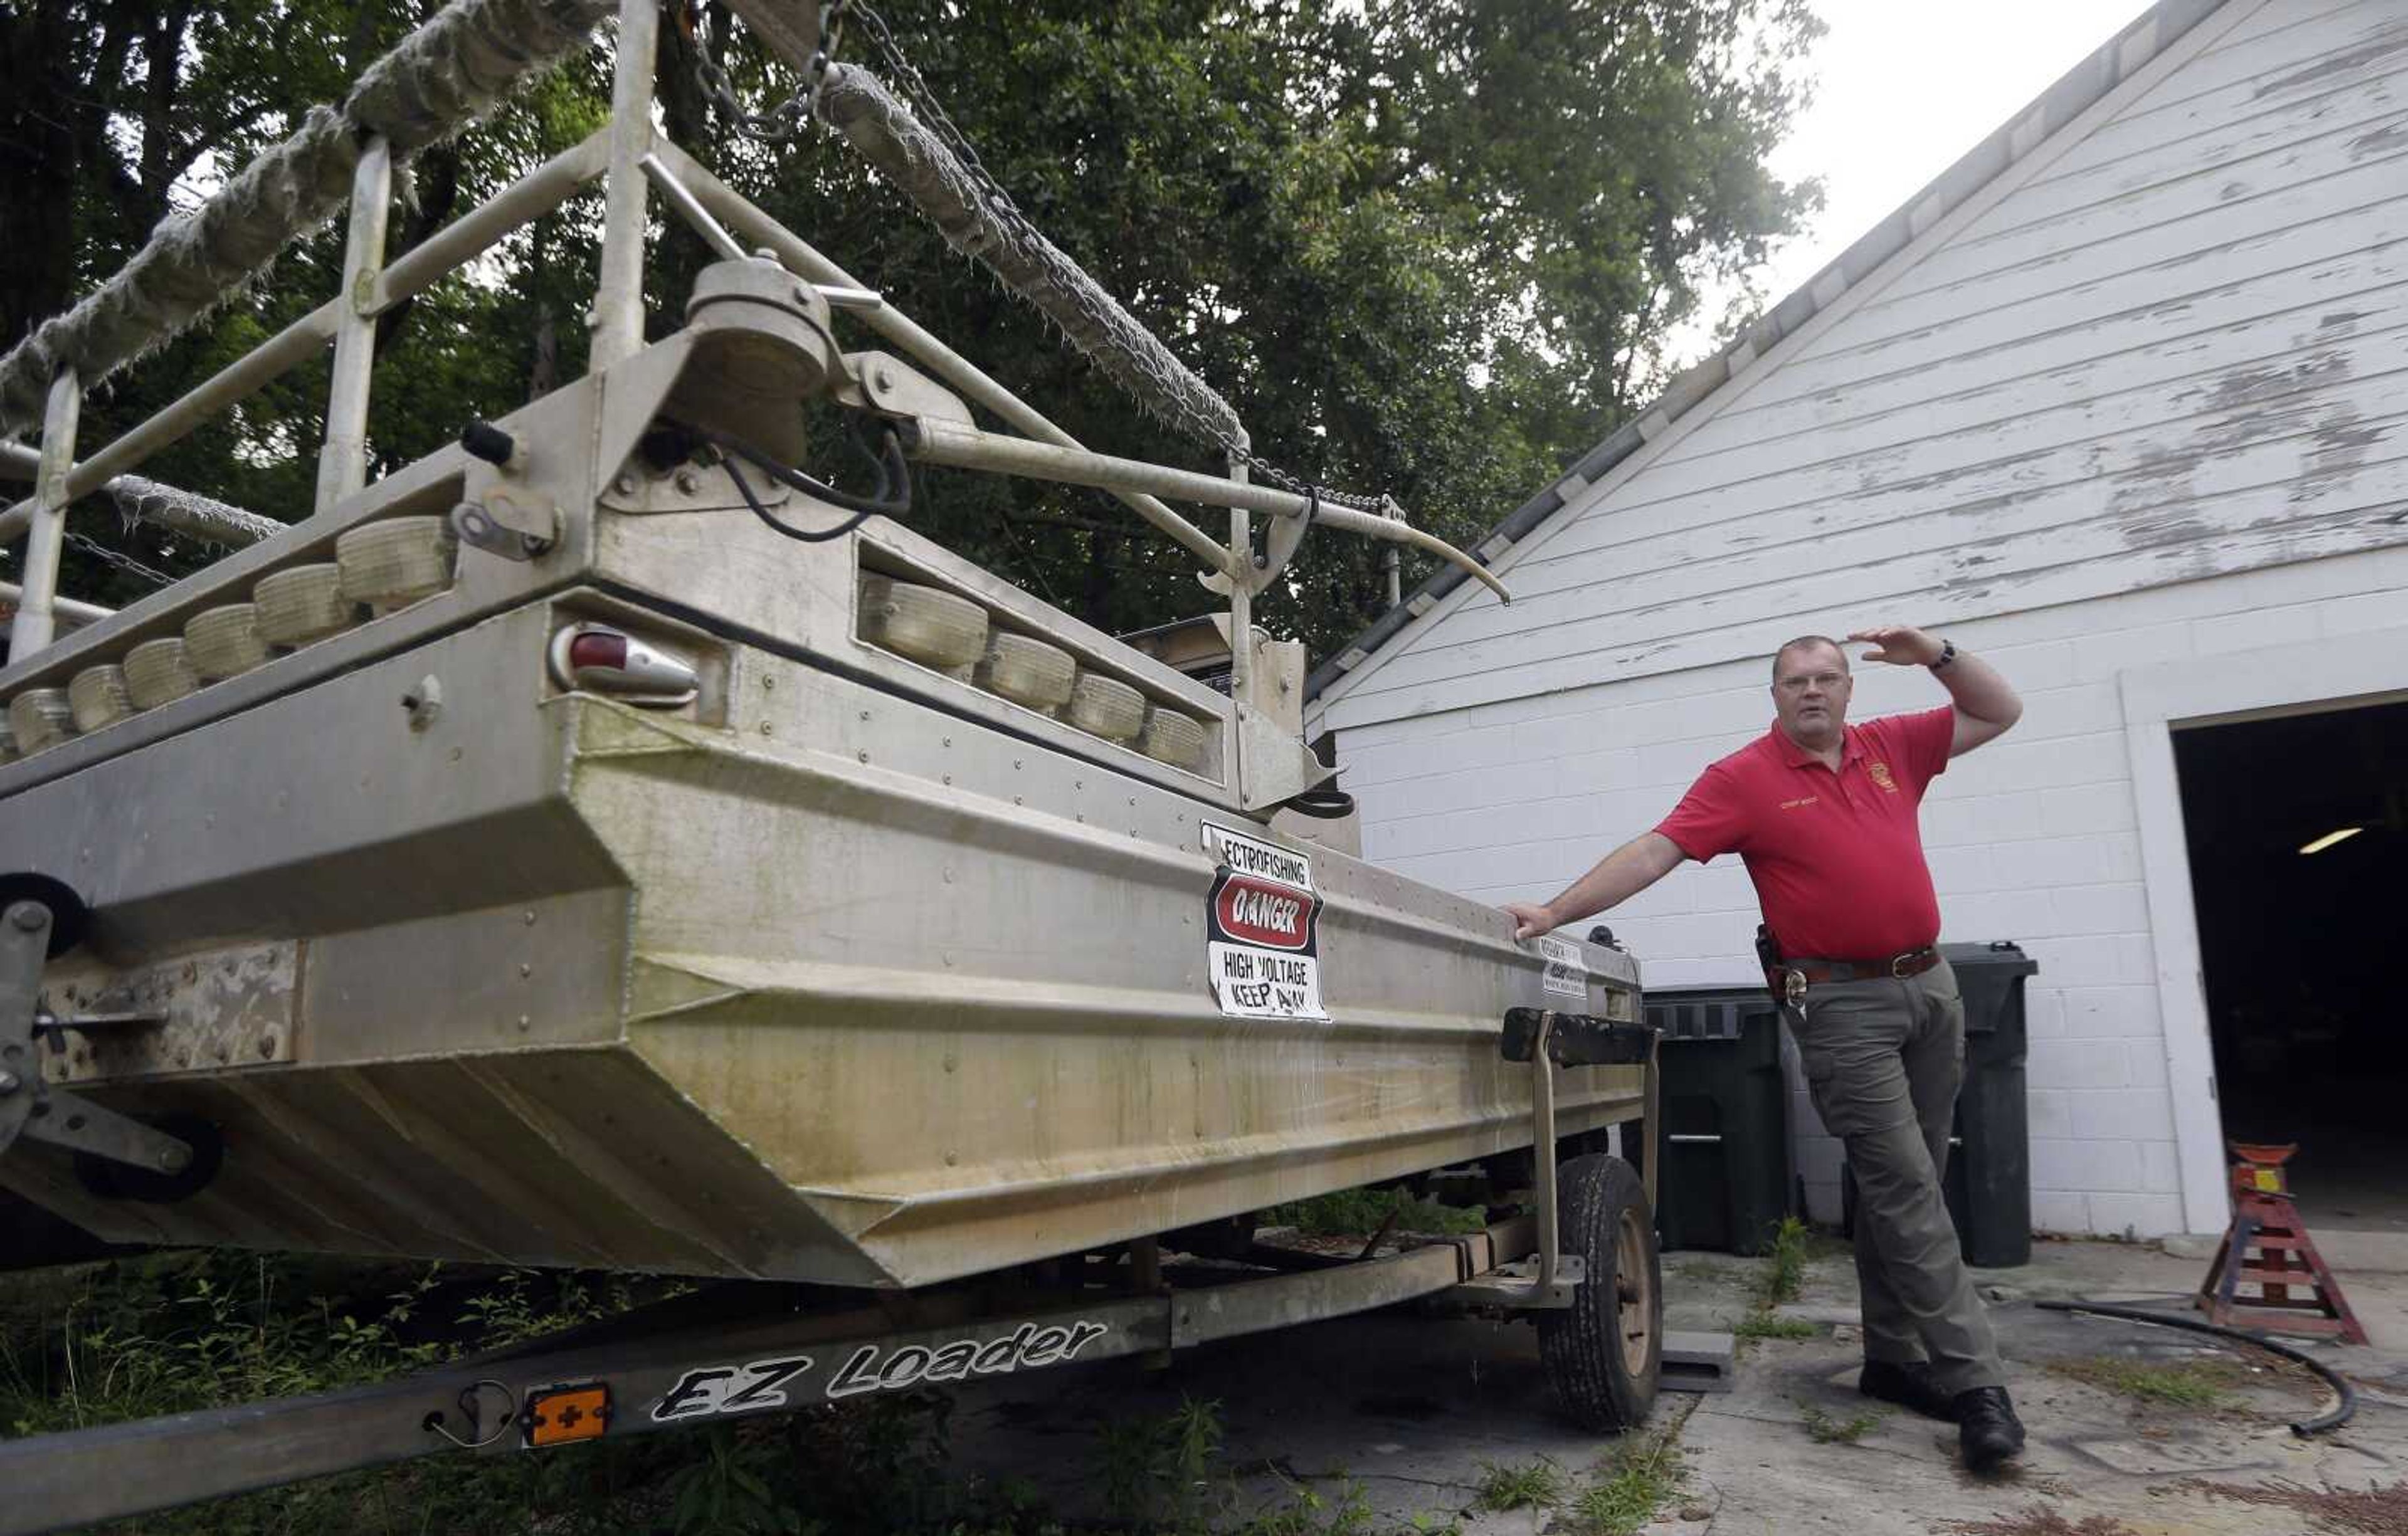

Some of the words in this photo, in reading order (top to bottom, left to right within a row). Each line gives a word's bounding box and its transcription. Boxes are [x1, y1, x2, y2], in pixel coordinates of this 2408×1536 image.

[1232, 887, 1299, 934] DANGER
[1223, 950, 1254, 980] HIGH
[1257, 956, 1307, 986] VOLTAGE
[1231, 982, 1270, 1008] KEEP
[1275, 987, 1307, 1014] AAY
[652, 1356, 814, 1421] EZ
[826, 1322, 1108, 1397] Loader
